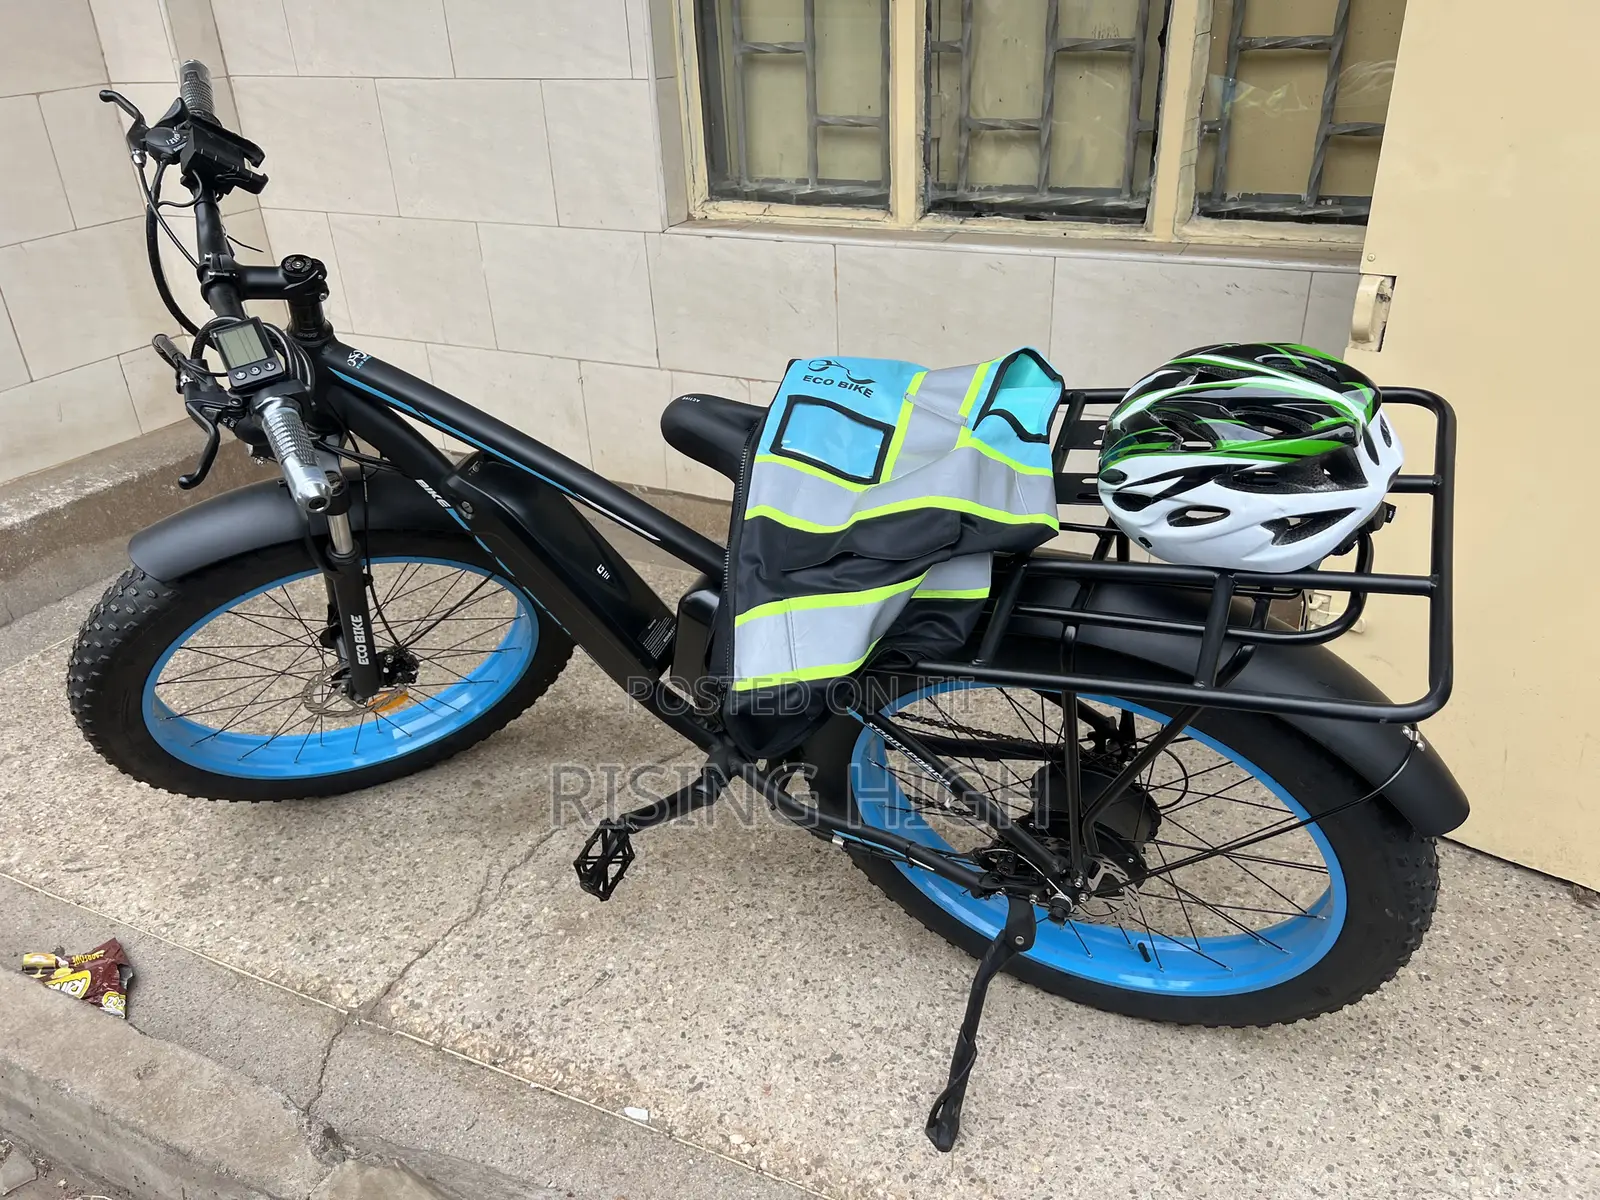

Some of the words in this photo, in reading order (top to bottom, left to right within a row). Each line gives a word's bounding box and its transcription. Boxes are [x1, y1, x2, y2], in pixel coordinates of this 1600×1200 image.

[803, 375, 834, 386] ECO
[838, 381, 874, 399] BIKE
[415, 479, 452, 508] BIKE
[350, 614, 366, 643] BIKE
[355, 644, 370, 665] ECO
